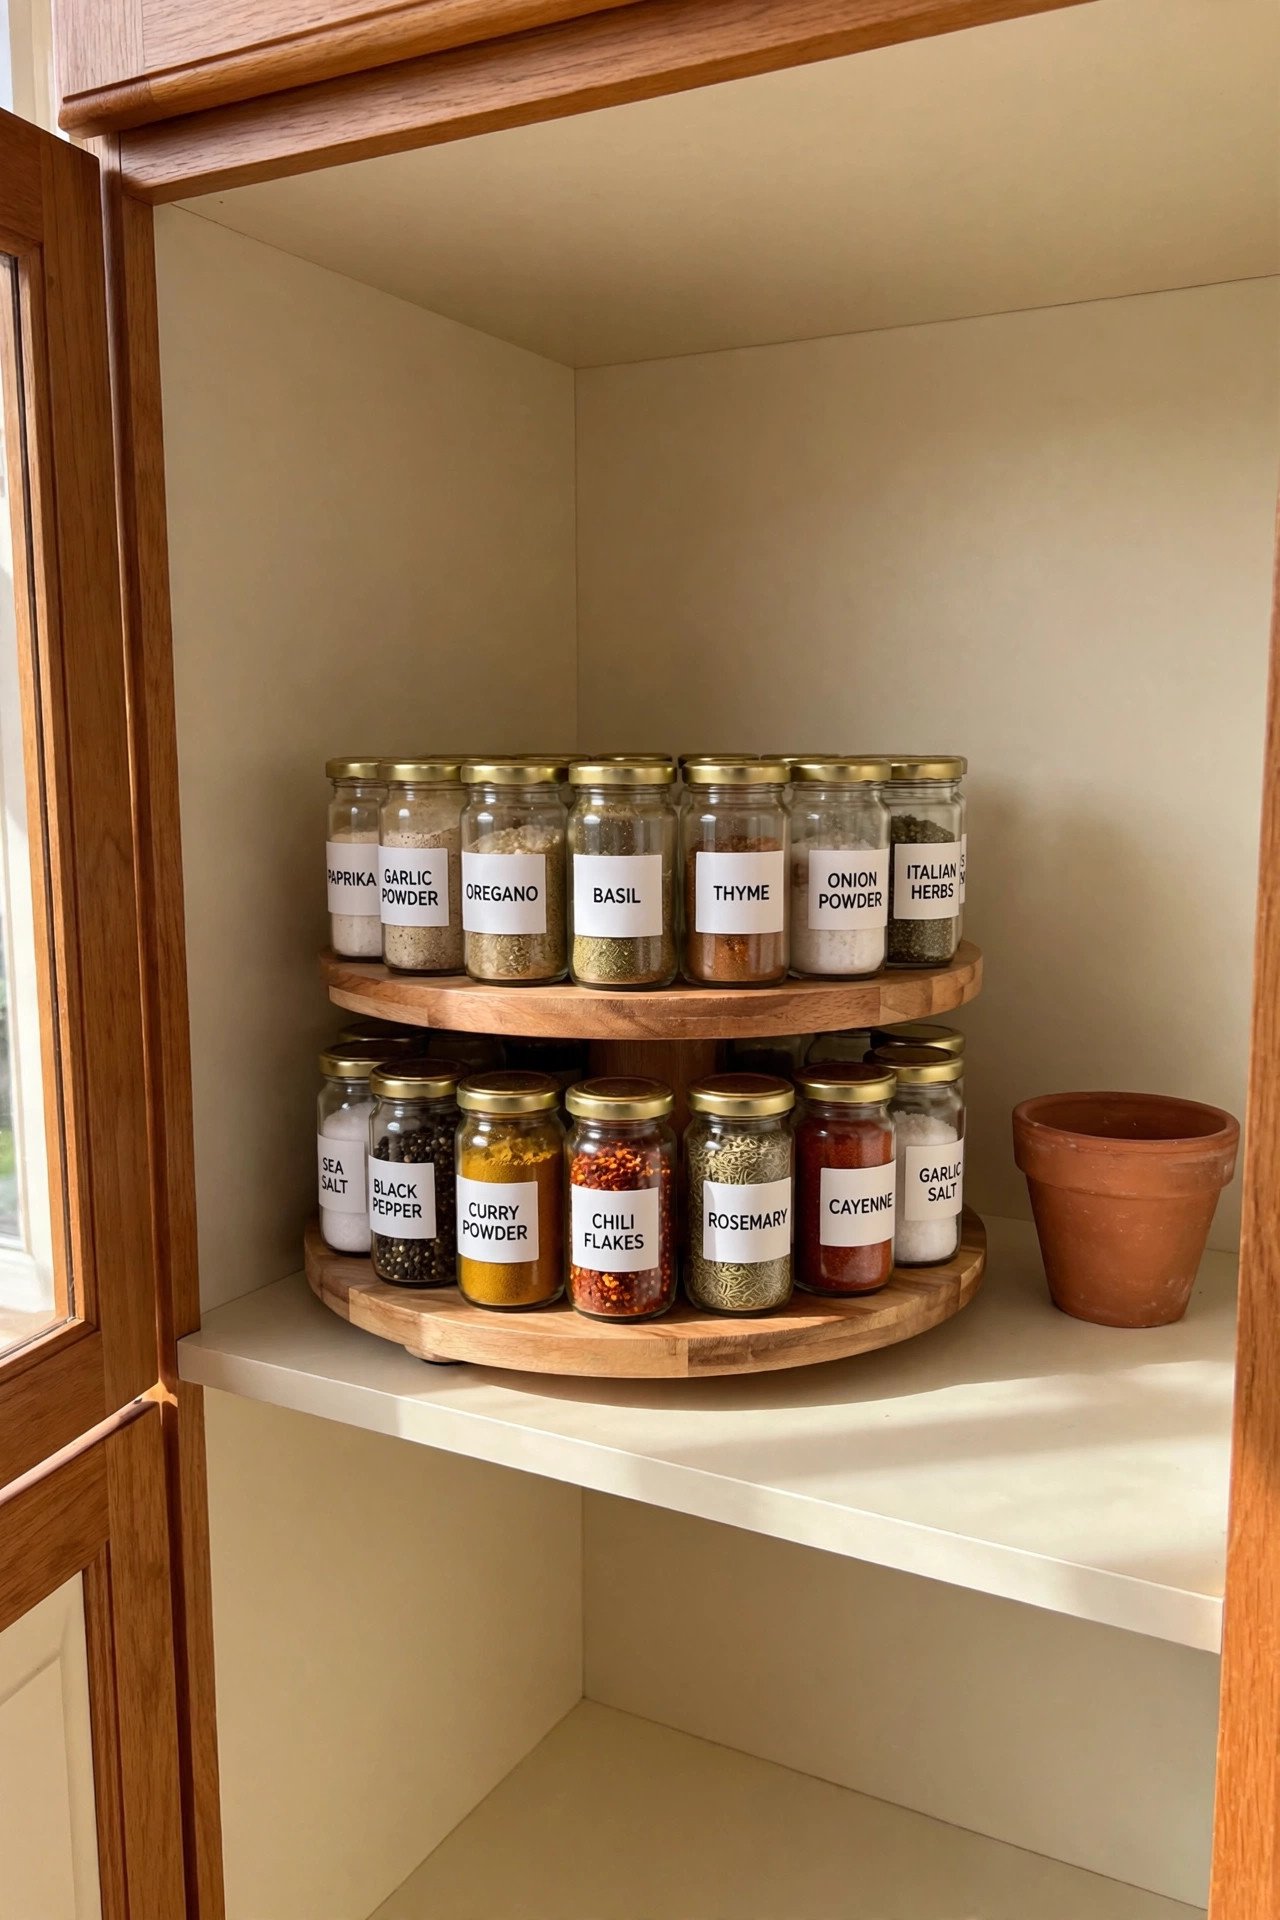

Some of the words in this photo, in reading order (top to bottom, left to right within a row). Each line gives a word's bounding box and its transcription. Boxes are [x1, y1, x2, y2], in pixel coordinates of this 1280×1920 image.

[384, 868, 432, 886] GARLIC
[828, 871, 877, 888] ONION
[907, 863, 956, 880] ITALIAN
[382, 888, 439, 906] POWDER
[466, 883, 539, 902] OREGANO
[593, 887, 641, 904] BASIL
[713, 884, 770, 901] THYME
[819, 891, 882, 910] POWDER
[911, 883, 954, 900] HERBS
[322, 1157, 344, 1176] SEA
[919, 1161, 962, 1183] GARLIC
[322, 1175, 348, 1194] SALT
[374, 1179, 417, 1199] BLACK
[927, 1182, 957, 1202] SALT
[372, 1197, 422, 1219] PEPPER
[469, 1202, 519, 1221] CURRY
[829, 1192, 893, 1215] CAYENNE
[592, 1213, 635, 1230] CHILI
[708, 1208, 788, 1231] ROSEMARY
[462, 1220, 528, 1241] POWDER
[584, 1233, 645, 1251] FLAKES
